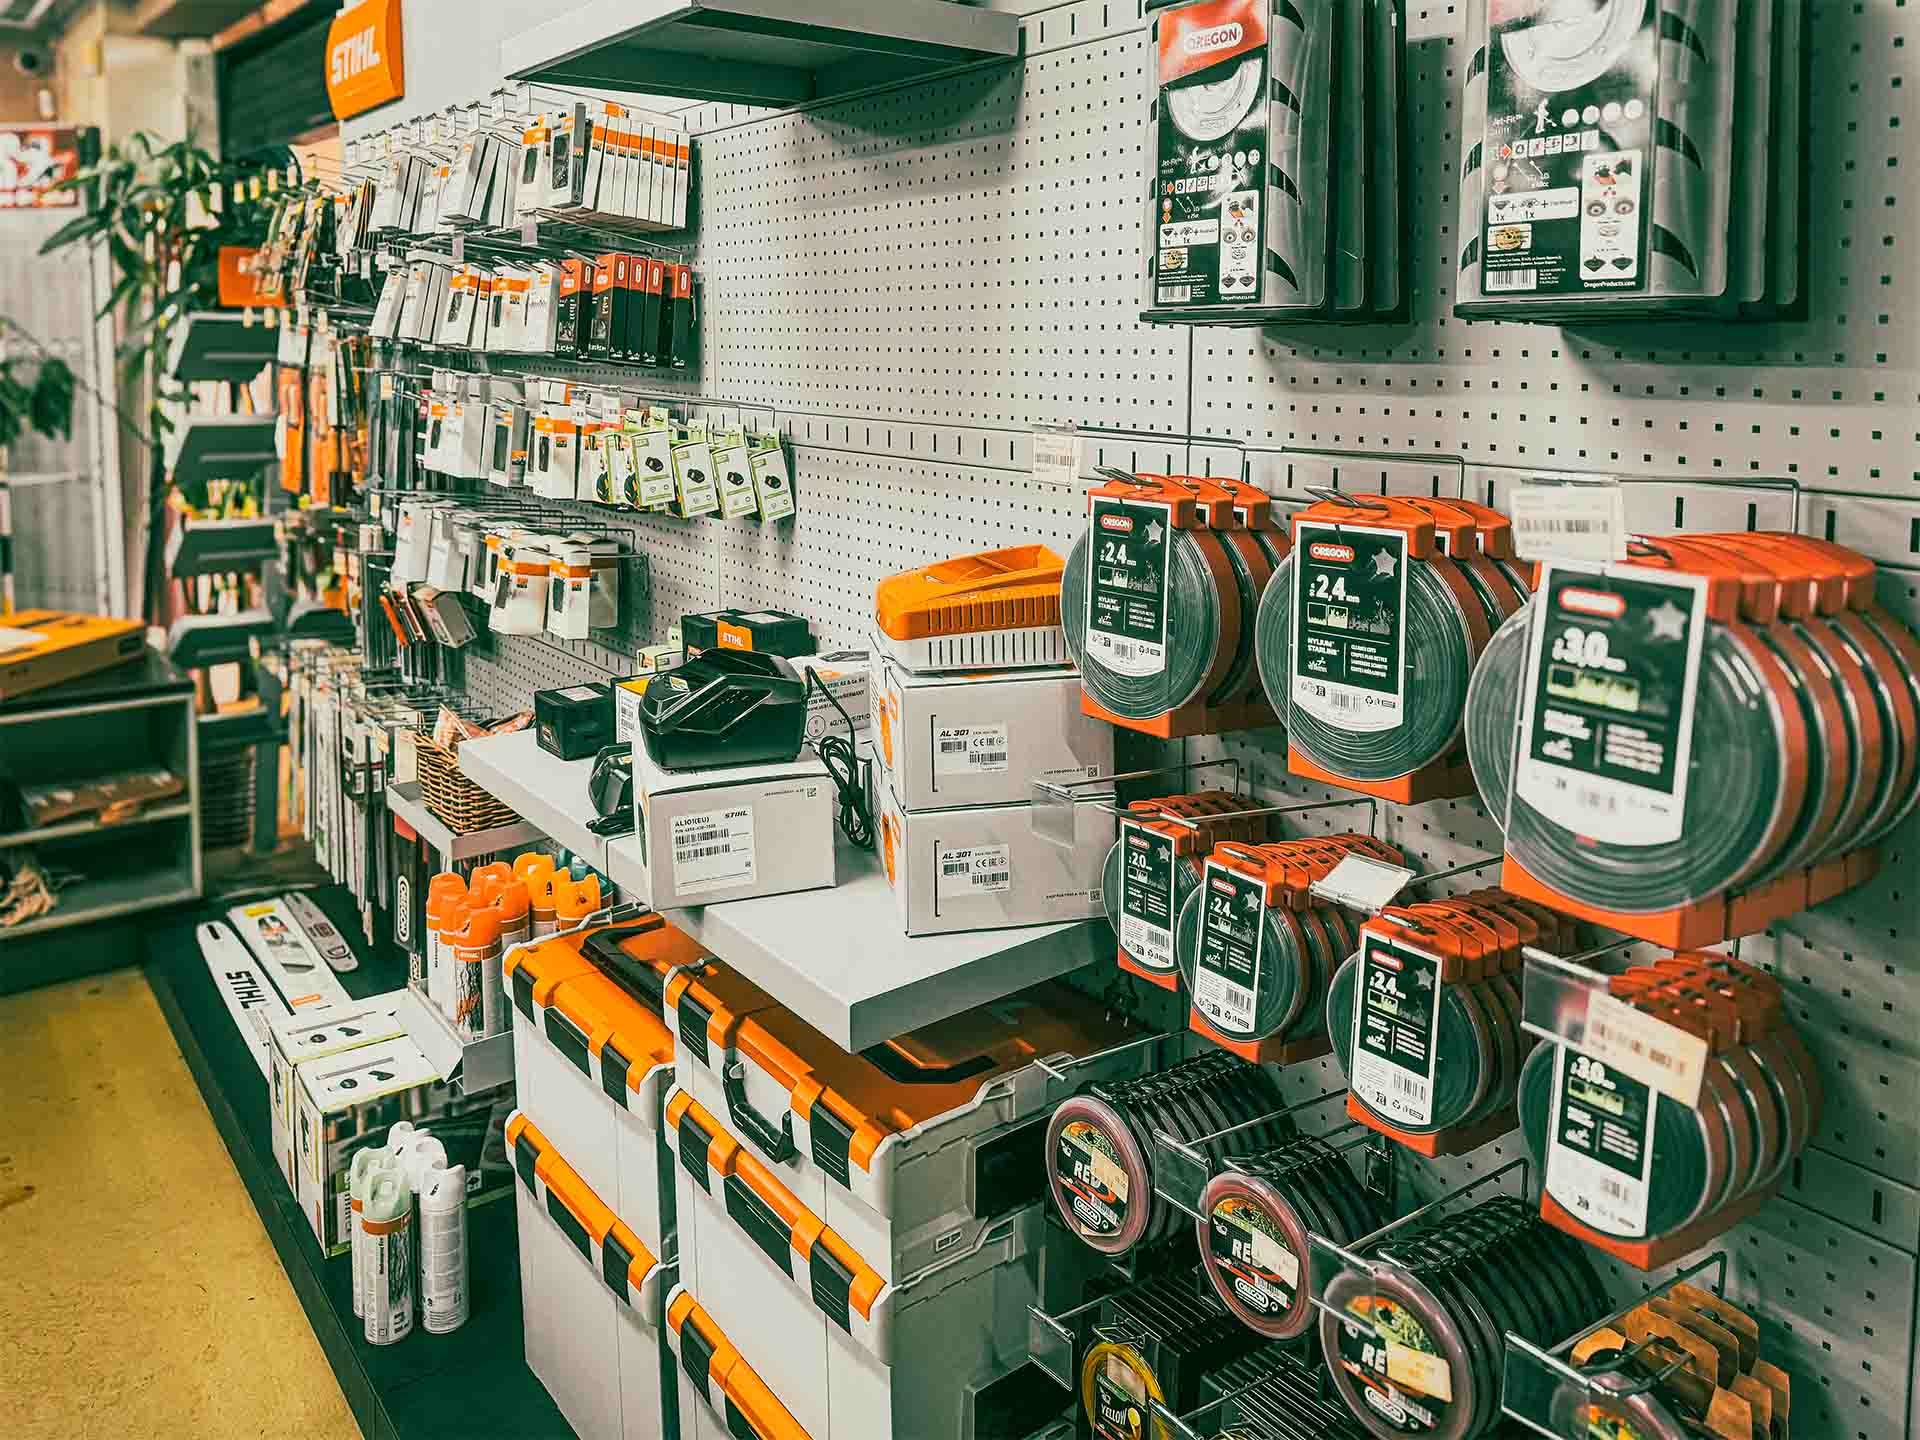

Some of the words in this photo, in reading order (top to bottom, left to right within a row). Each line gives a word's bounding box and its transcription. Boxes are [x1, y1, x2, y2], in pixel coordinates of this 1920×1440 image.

[331, 25, 380, 86] STIHL
[1312, 546, 1350, 560] OREGON
[722, 631, 744, 647] STIHL
[953, 729, 970, 737] 301
[724, 810, 748, 819] STIHL
[955, 850, 972, 859] 301
[225, 970, 268, 1010] STIHL
[1101, 1403, 1128, 1426] YELLOW
